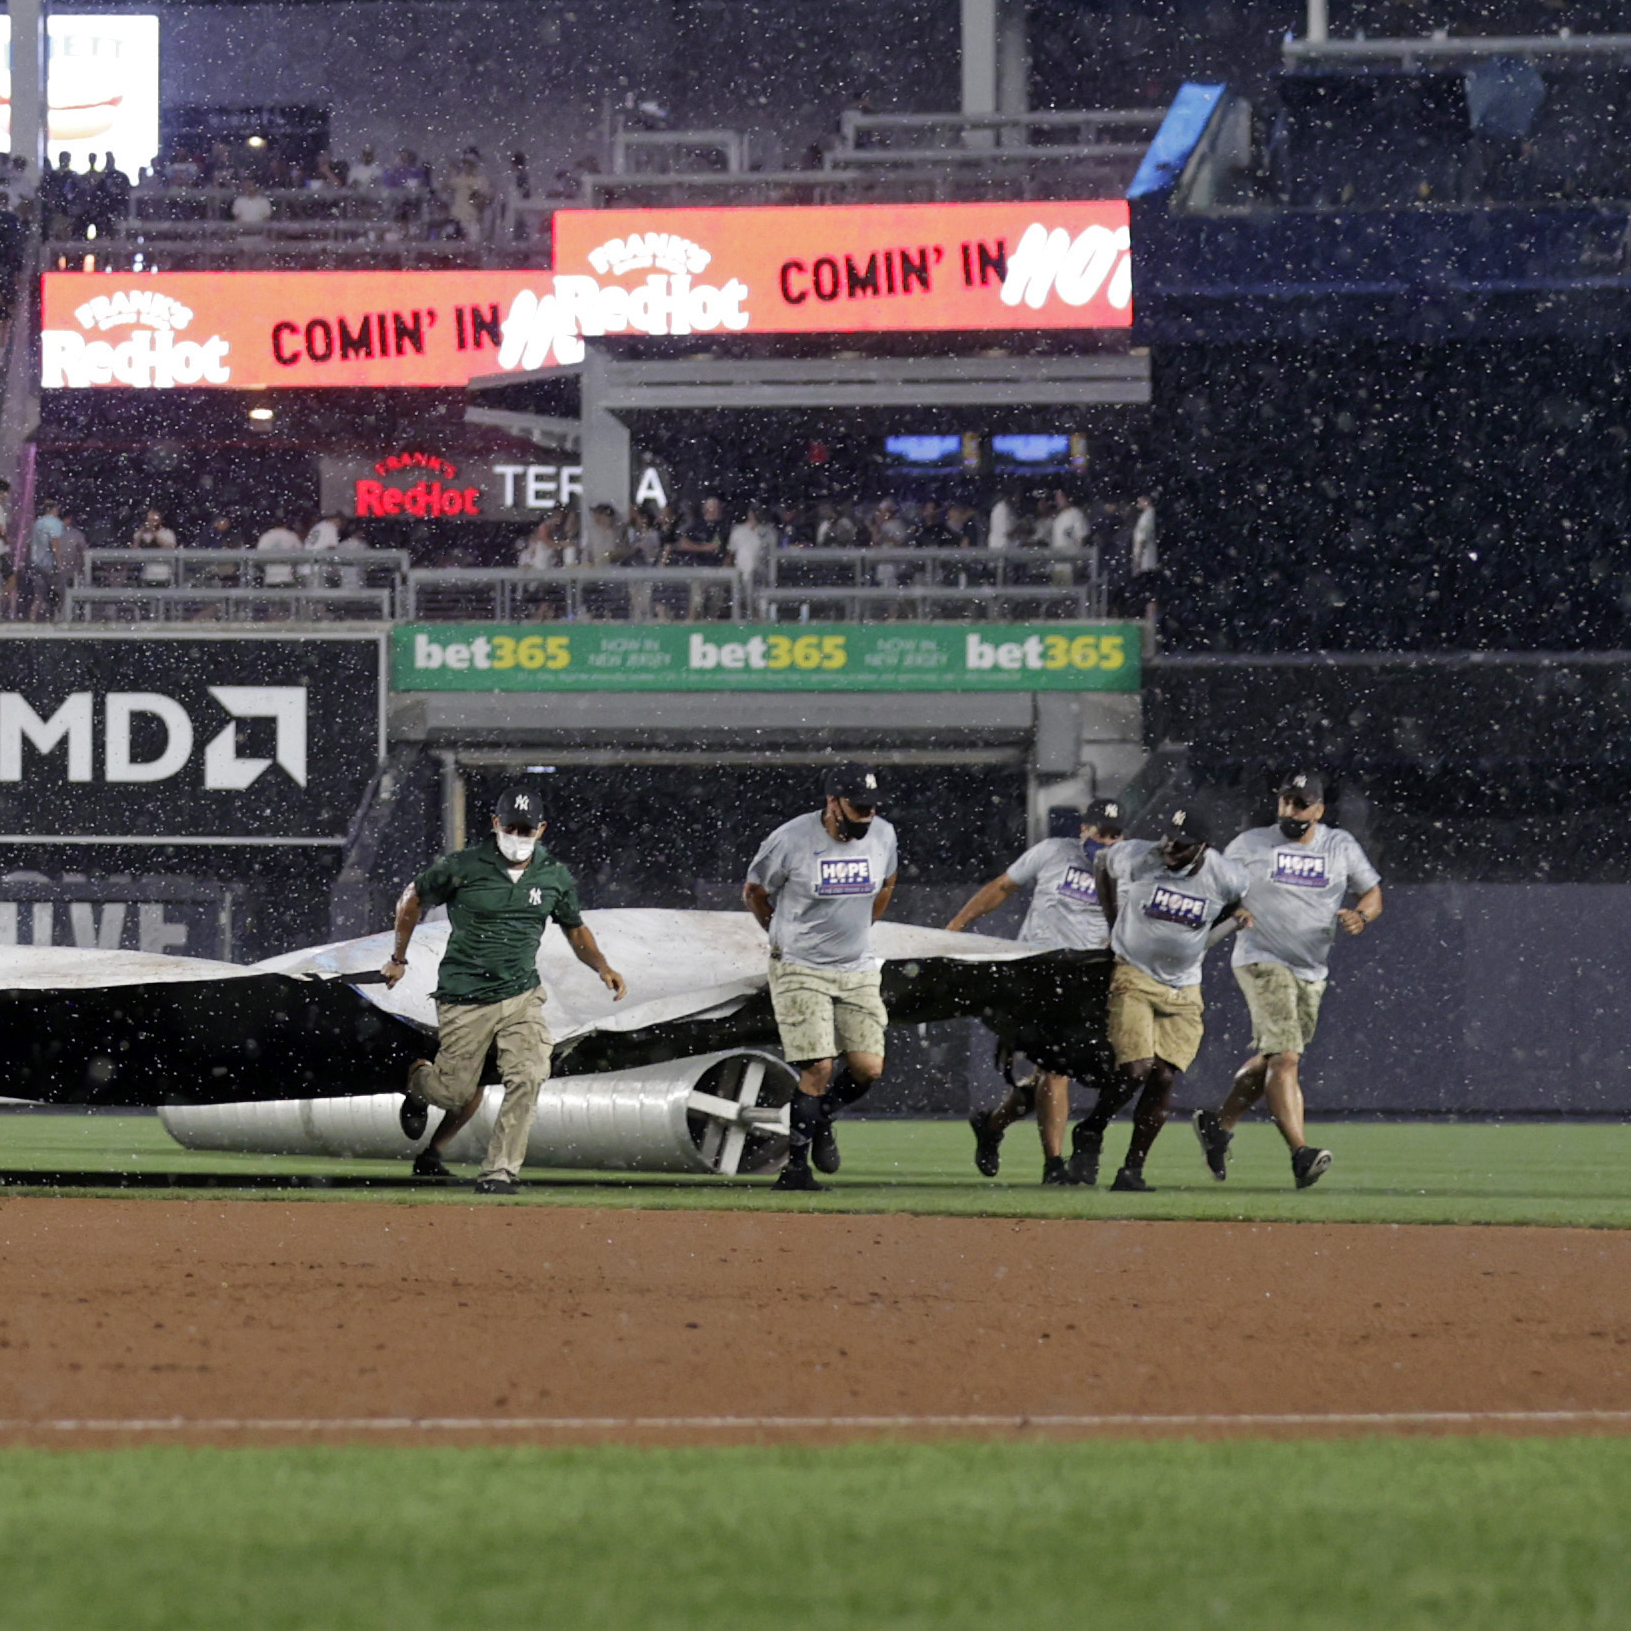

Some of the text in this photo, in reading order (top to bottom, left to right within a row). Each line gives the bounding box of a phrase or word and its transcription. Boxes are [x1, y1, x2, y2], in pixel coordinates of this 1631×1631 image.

[780, 248, 942, 305] COMIN'
[961, 240, 1008, 287] IN
[554, 272, 750, 335] RedHot
[271, 309, 436, 365] COMIN'
[455, 304, 502, 350] IN
[40, 329, 231, 388] RedHot
[355, 479, 481, 517] RedHot
[414, 633, 571, 669] bet365
[689, 633, 847, 669] bet365
[966, 633, 1125, 669] bet365
[514, 794, 530, 810] NY
[822, 862, 869, 878] HOPE
[1278, 855, 1324, 873] HOPE
[528, 887, 542, 905] NY
[1154, 890, 1204, 915] HOPE
